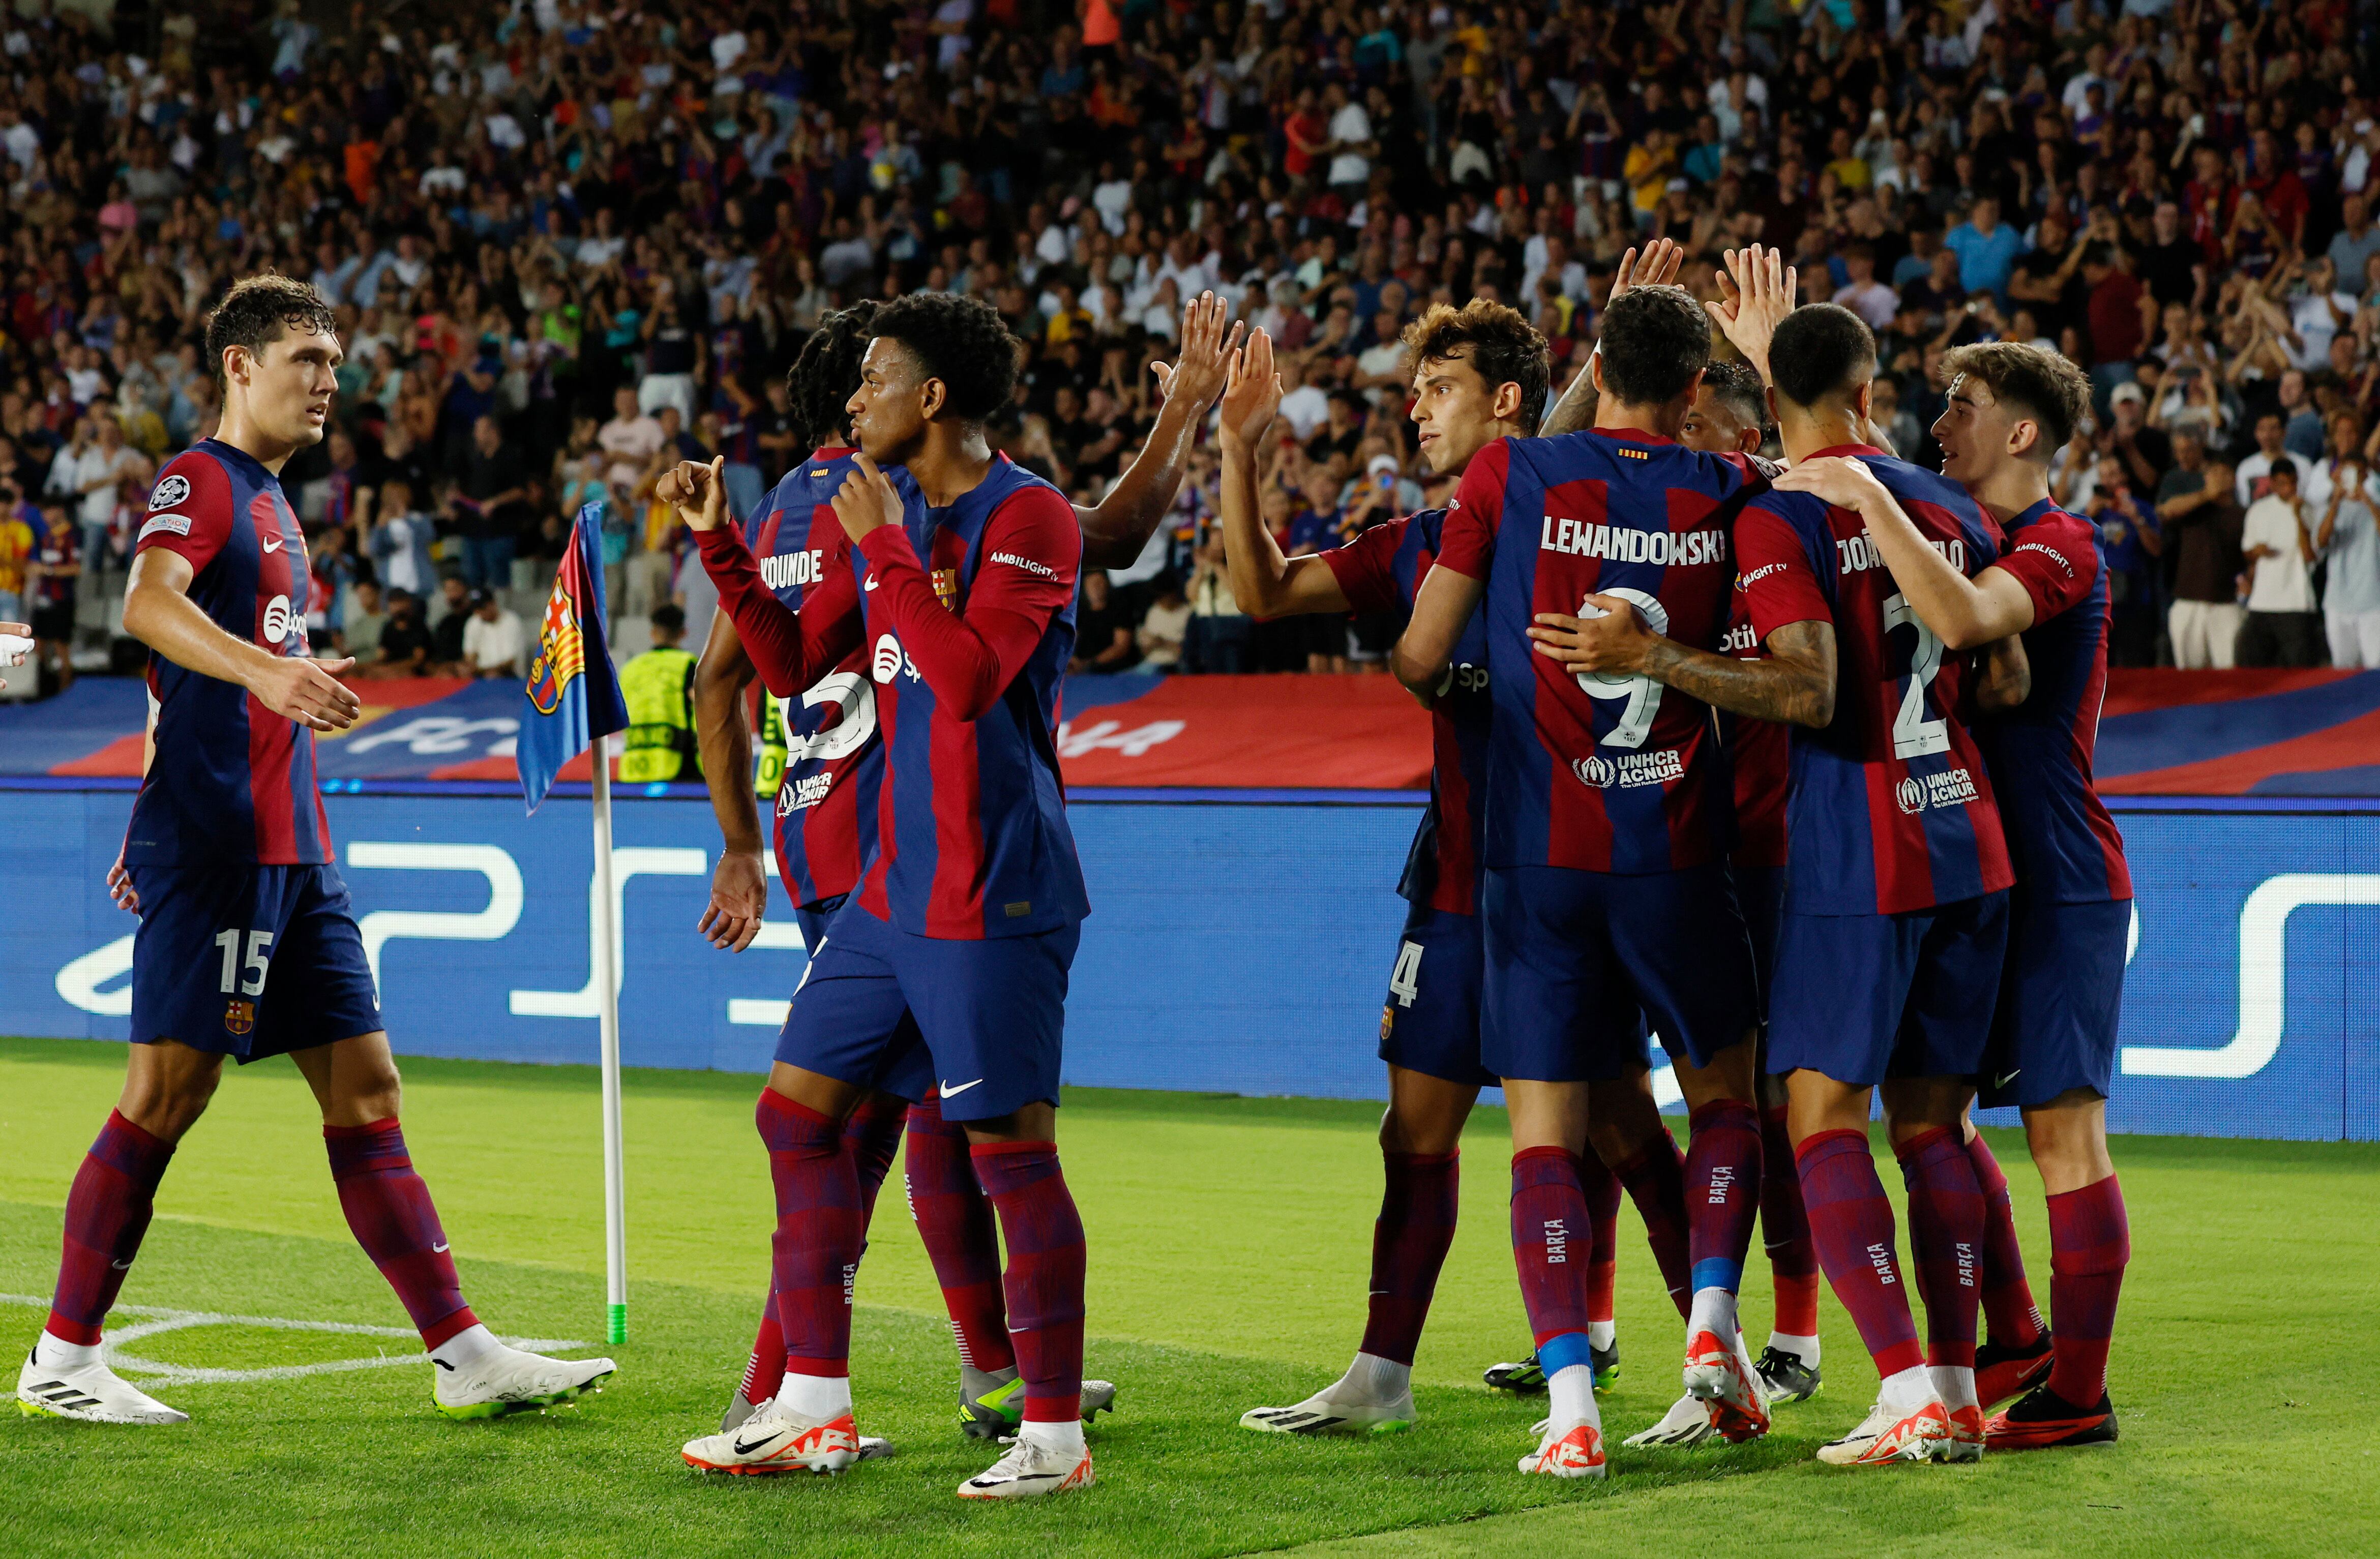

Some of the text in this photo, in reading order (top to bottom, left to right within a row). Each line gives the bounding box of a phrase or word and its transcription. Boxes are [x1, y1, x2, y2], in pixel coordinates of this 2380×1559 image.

[760, 549, 823, 590] KOUNDE
[990, 551, 1053, 577] AMBILIGHT
[1775, 562, 1787, 571] tv
[2015, 543, 2069, 568] AMBILIGHT
[1578, 588, 1669, 748] 9
[1883, 593, 1951, 760] 2
[1617, 749, 1680, 770] UNHCR
[1619, 763, 1683, 785] ACNUR
[1642, 778, 1664, 787] Refugee
[1664, 772, 1685, 782] Agency
[1926, 768, 1971, 789] UNHCR
[1931, 782, 1977, 803] ACNUR
[215, 928, 274, 996] 15
[1709, 1166, 1735, 1204] BARÇA
[1544, 1219, 1569, 1264] BARÇA
[1866, 1243, 1896, 1284] BARÇA
[1956, 1243, 1975, 1287] BARÇA
